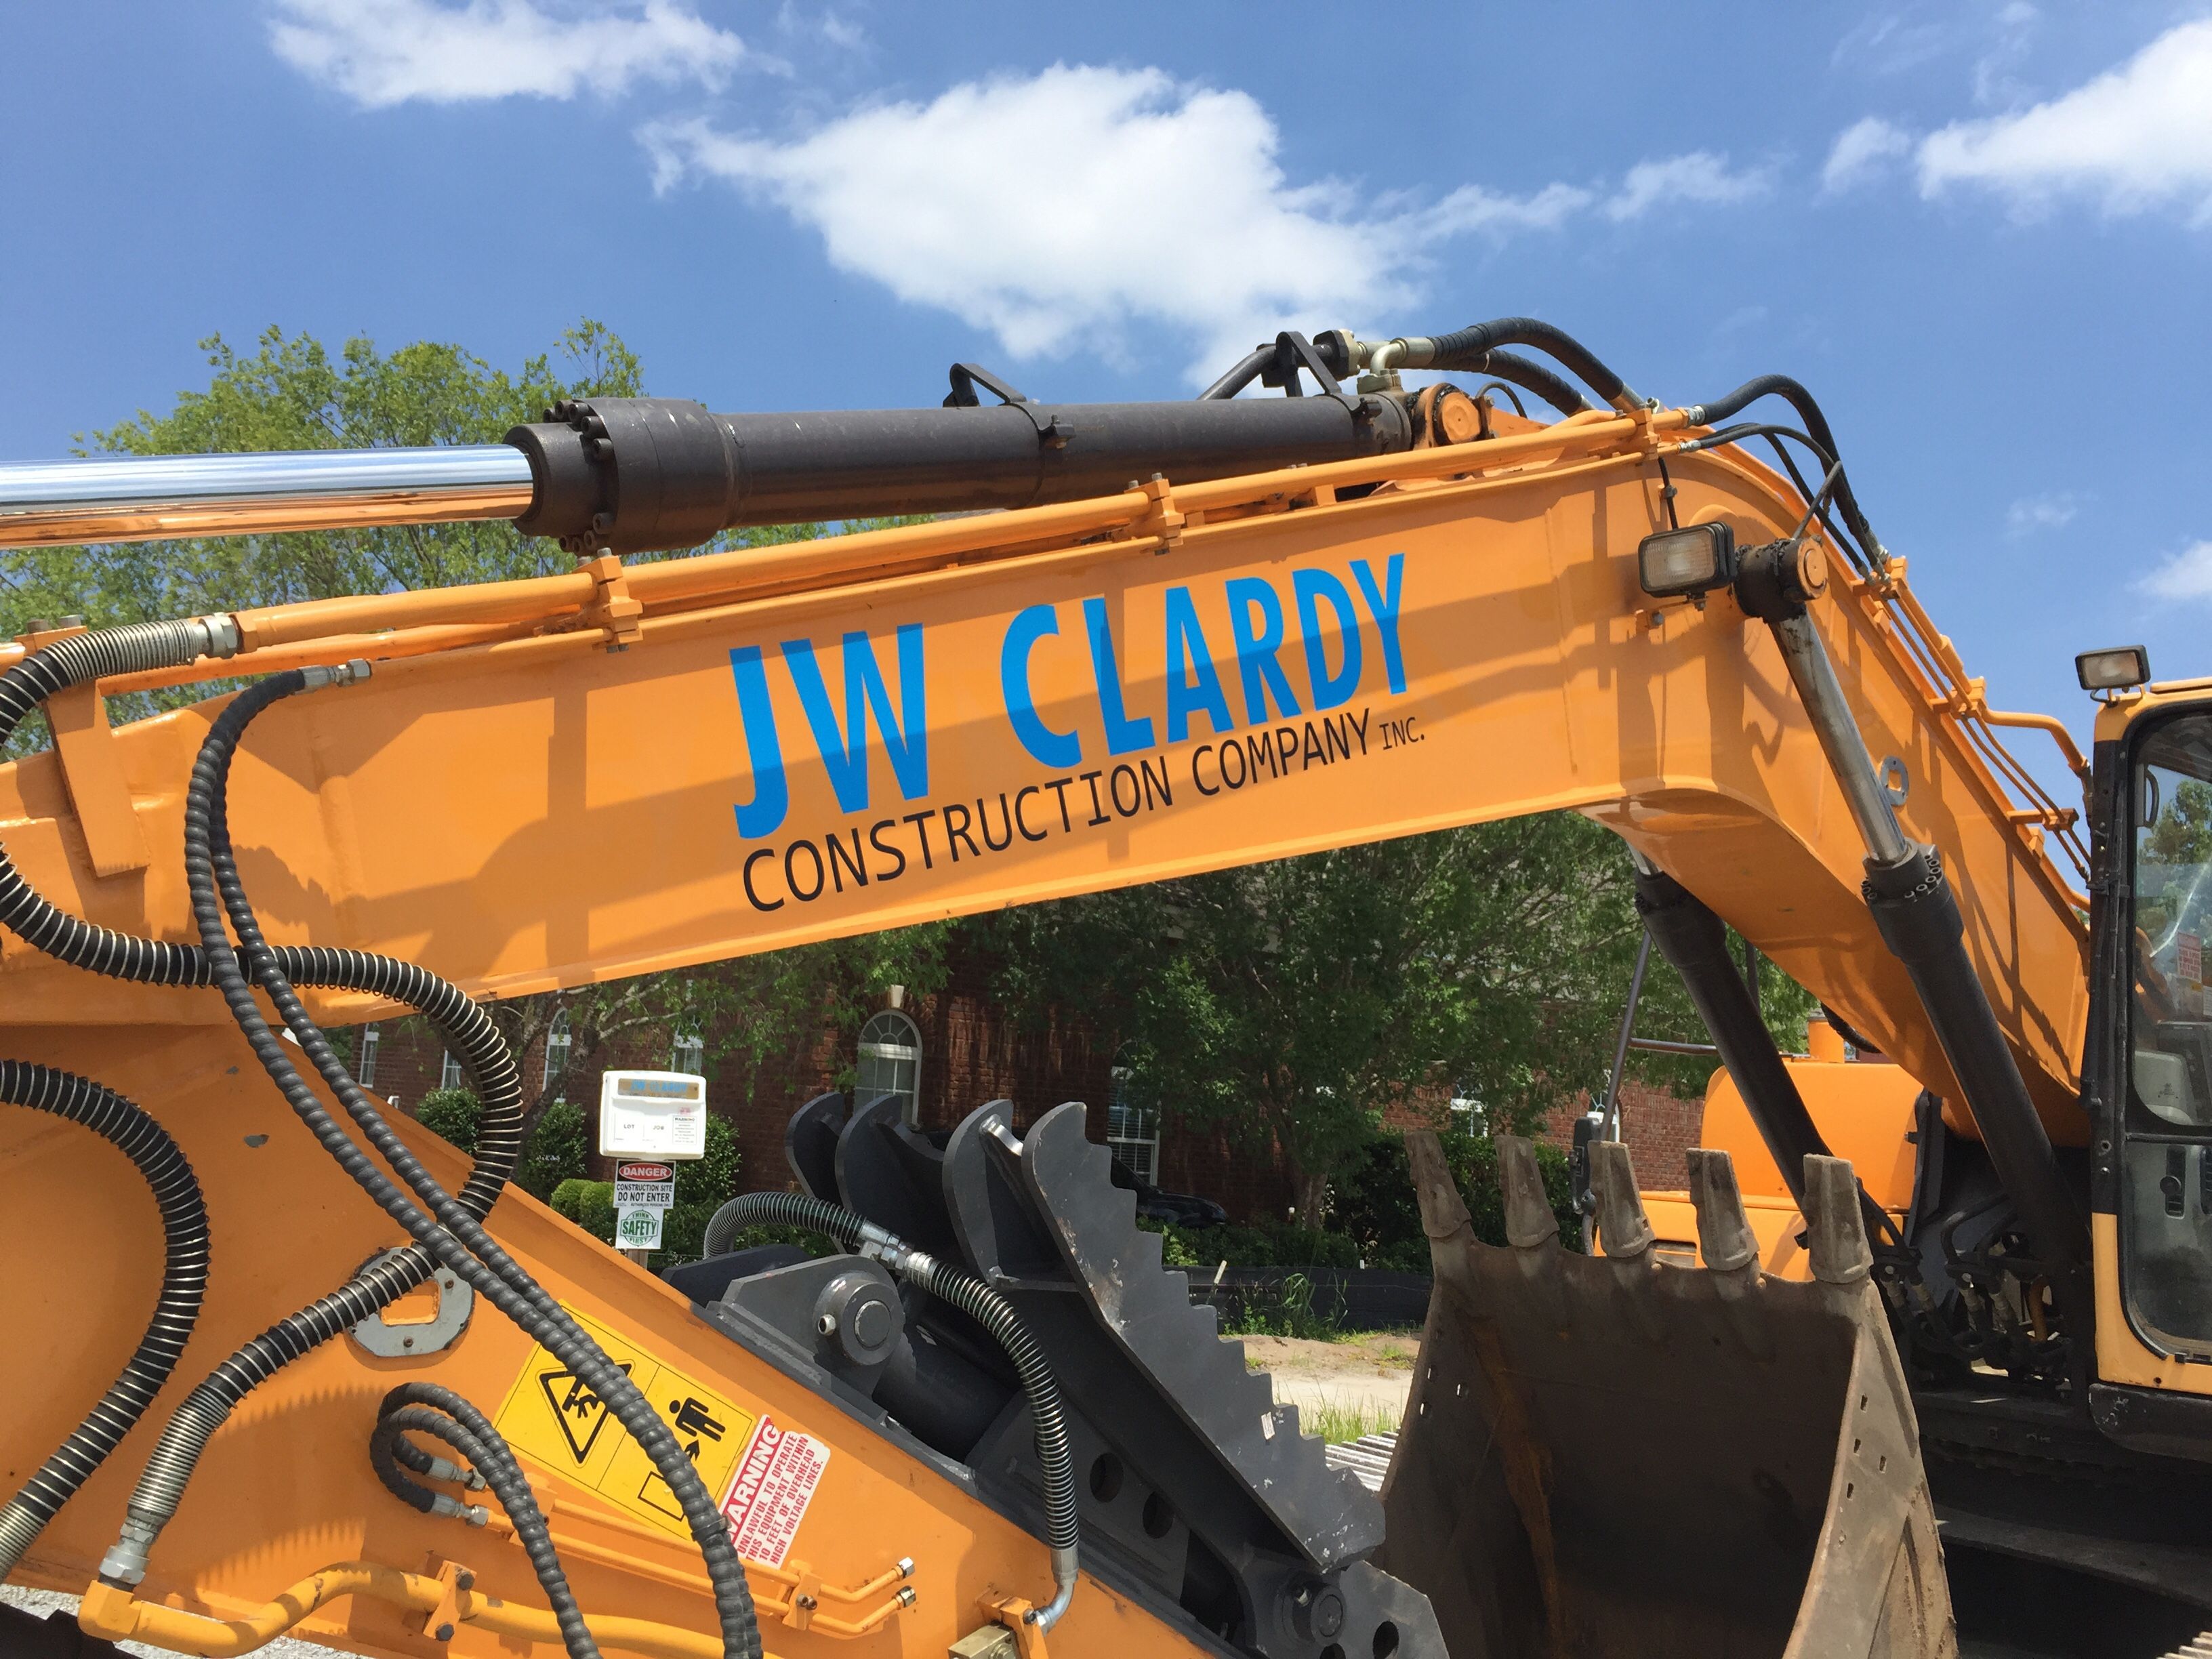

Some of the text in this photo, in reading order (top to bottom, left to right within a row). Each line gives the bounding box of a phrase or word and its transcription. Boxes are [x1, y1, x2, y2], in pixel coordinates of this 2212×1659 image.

[730, 553, 1407, 839] JW CLARDY
[743, 708, 1425, 912] CONSTRUCTION COMPANY INC.
[617, 1184, 659, 1192] CONSTRUCTION
[618, 1192, 670, 1202] DO NOT ENTER
[623, 1167, 667, 1176] DANGER
[622, 1221, 657, 1235] SAFETY
[737, 1433, 798, 1554] UNLAWFUL TO OPERATE
[746, 1436, 808, 1561] THIS EQUIPMENT WITHIN
[759, 1449, 815, 1560] 10 FEET OF OVERHEAD
[770, 1460, 823, 1565] HIGH VOLTAGE LINES.
